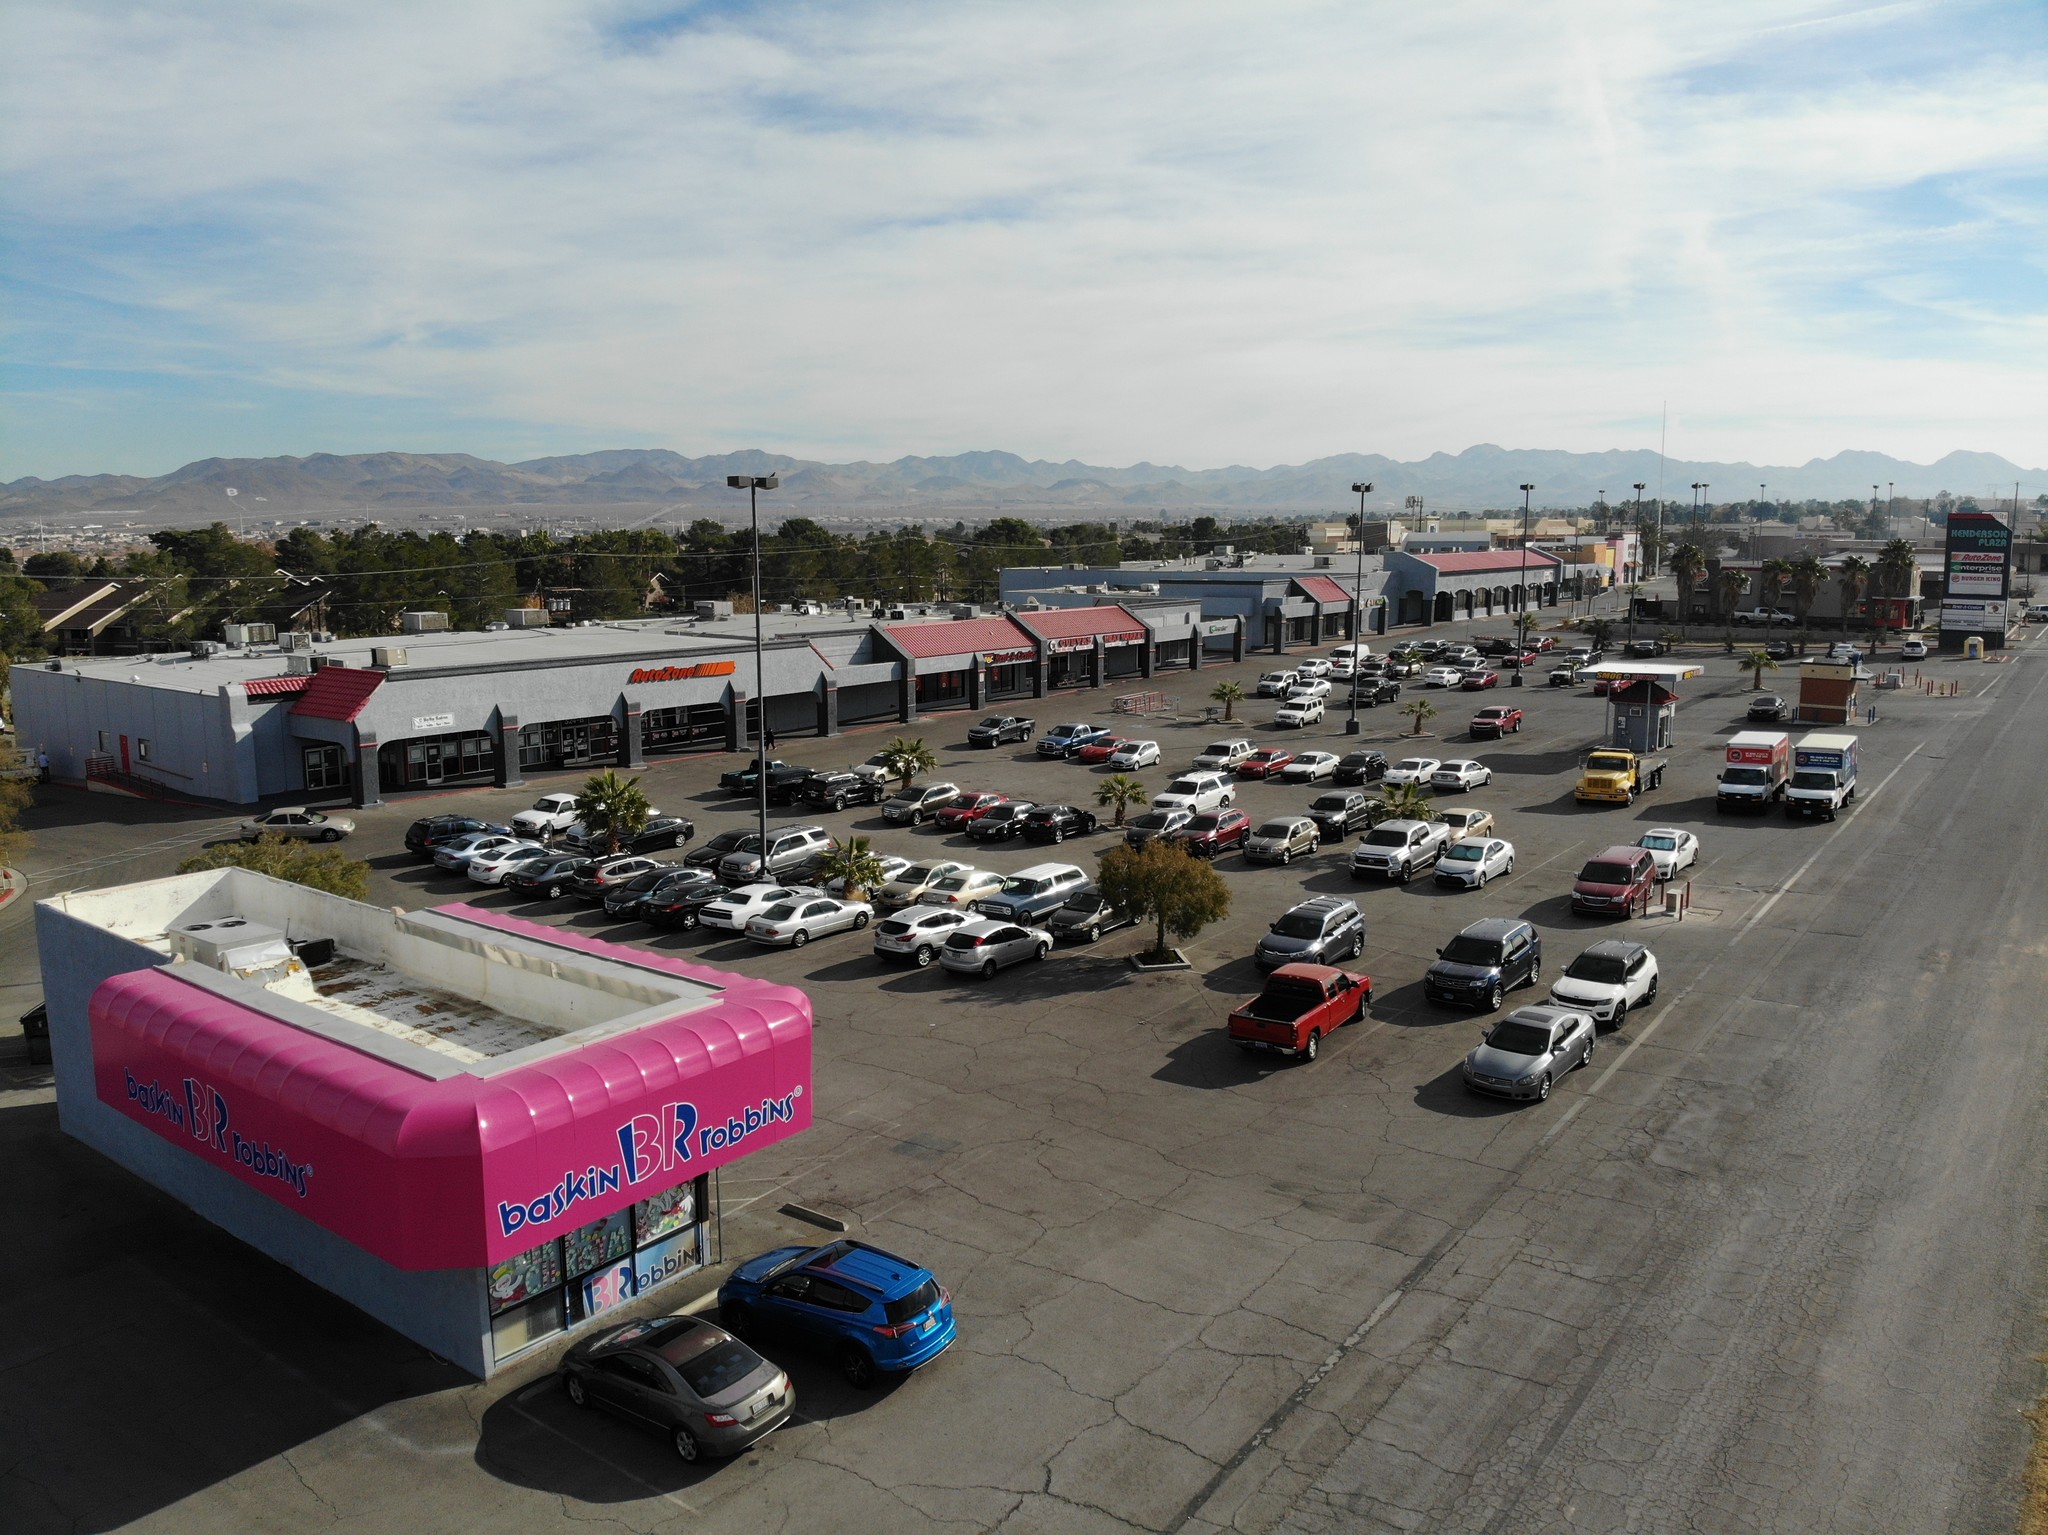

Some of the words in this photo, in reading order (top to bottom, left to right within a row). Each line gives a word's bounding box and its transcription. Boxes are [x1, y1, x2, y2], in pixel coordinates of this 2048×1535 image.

[1951, 529, 2008, 538] HENDERSON
[1978, 539, 2007, 547] PLAZA
[1951, 564, 2002, 572] enterprise
[629, 665, 697, 684] AutoZone
[1596, 671, 1623, 680] SMOG
[183, 1077, 228, 1152] BR
[616, 1102, 698, 1186] BR
[583, 1266, 632, 1316] BR
